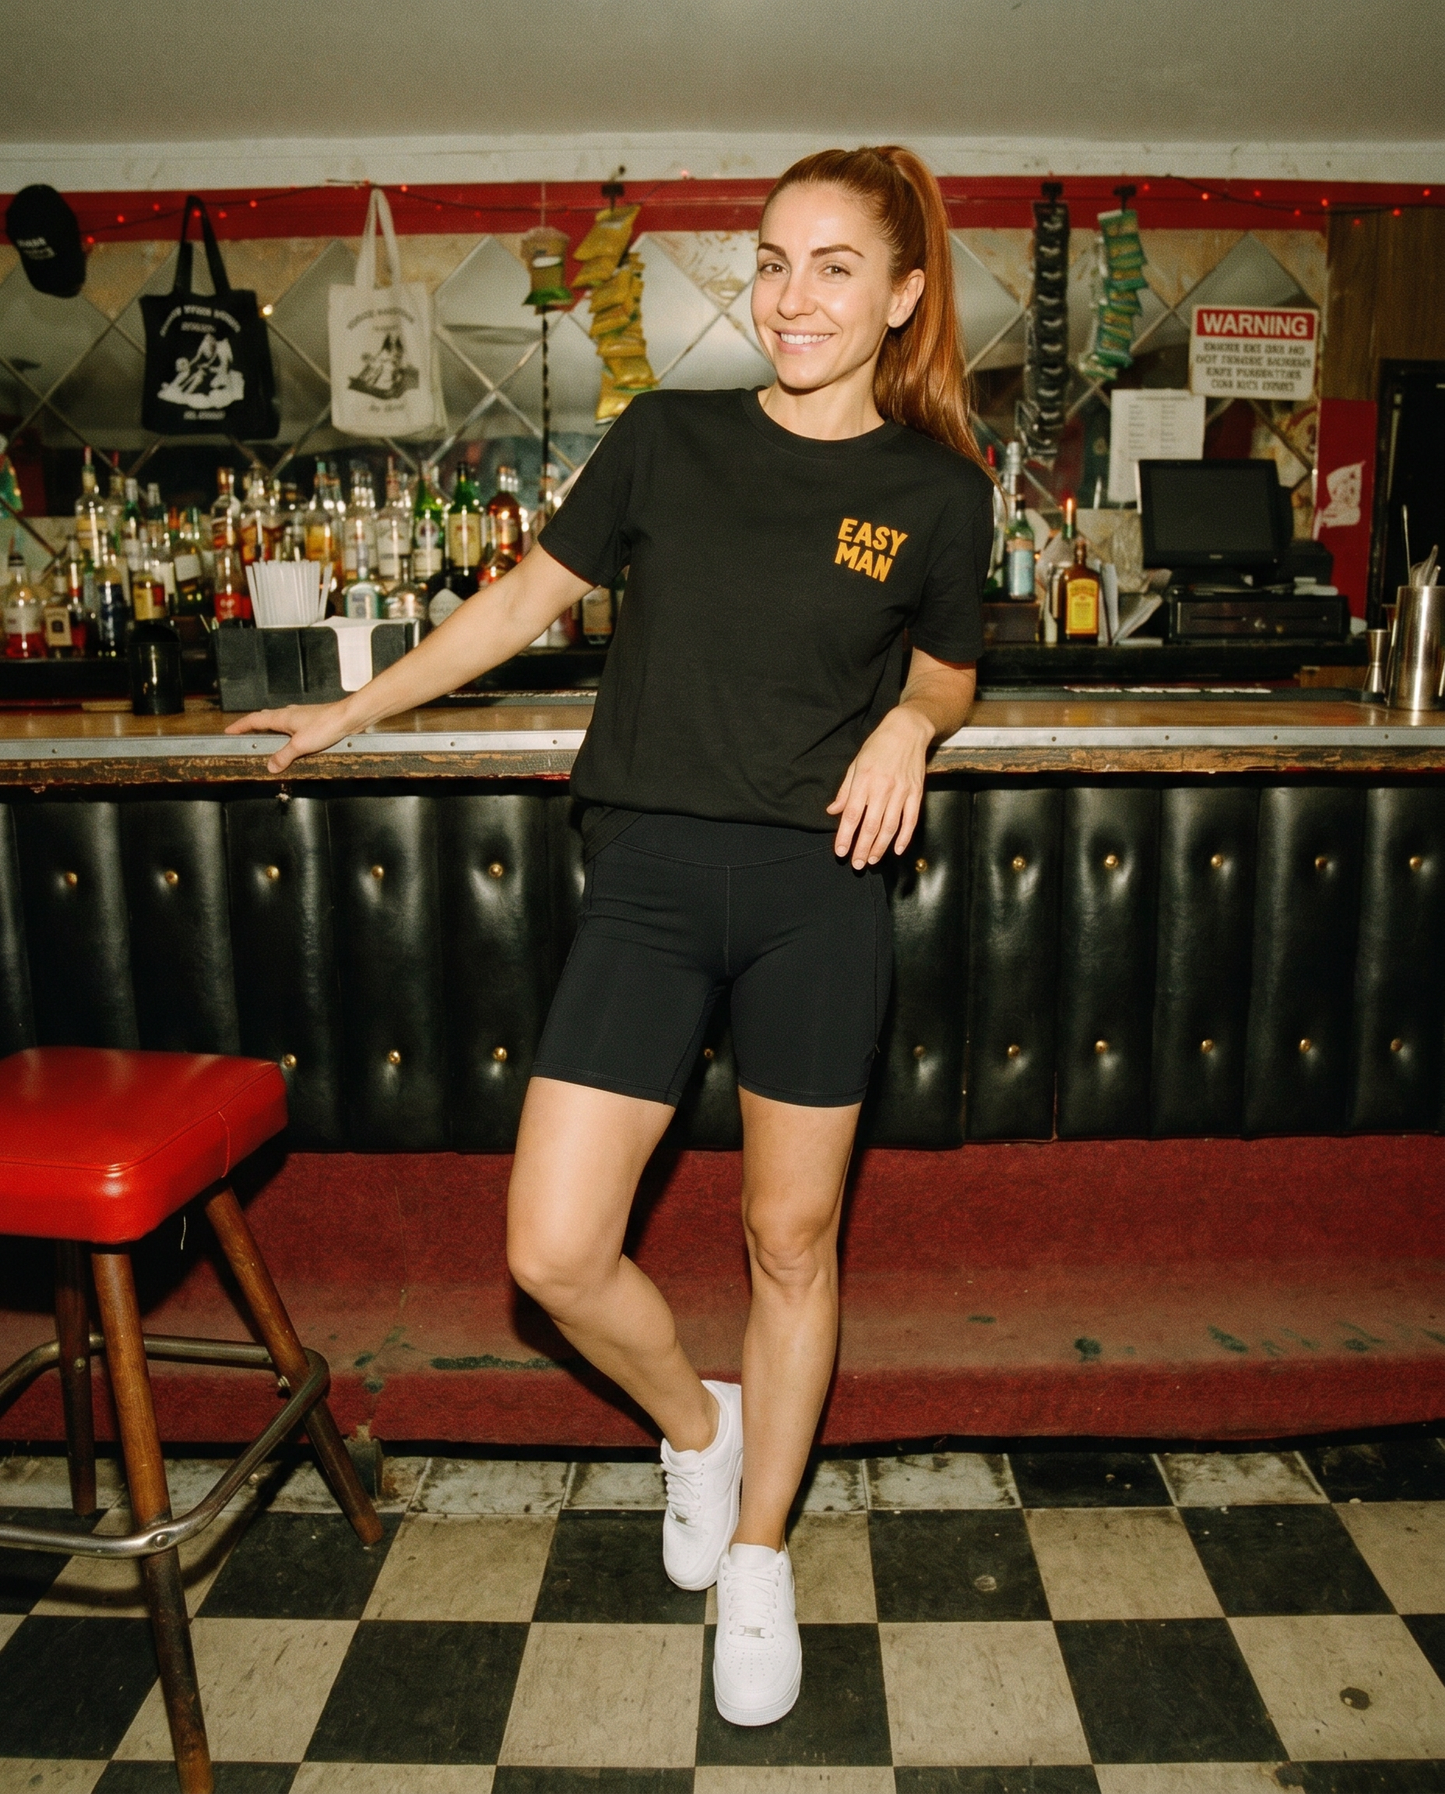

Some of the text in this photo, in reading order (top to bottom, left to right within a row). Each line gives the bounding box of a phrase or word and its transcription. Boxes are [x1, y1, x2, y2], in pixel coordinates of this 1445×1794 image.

[1202, 312, 1308, 337] WARNING
[838, 518, 908, 557] EASY
[834, 541, 893, 583] MAN
